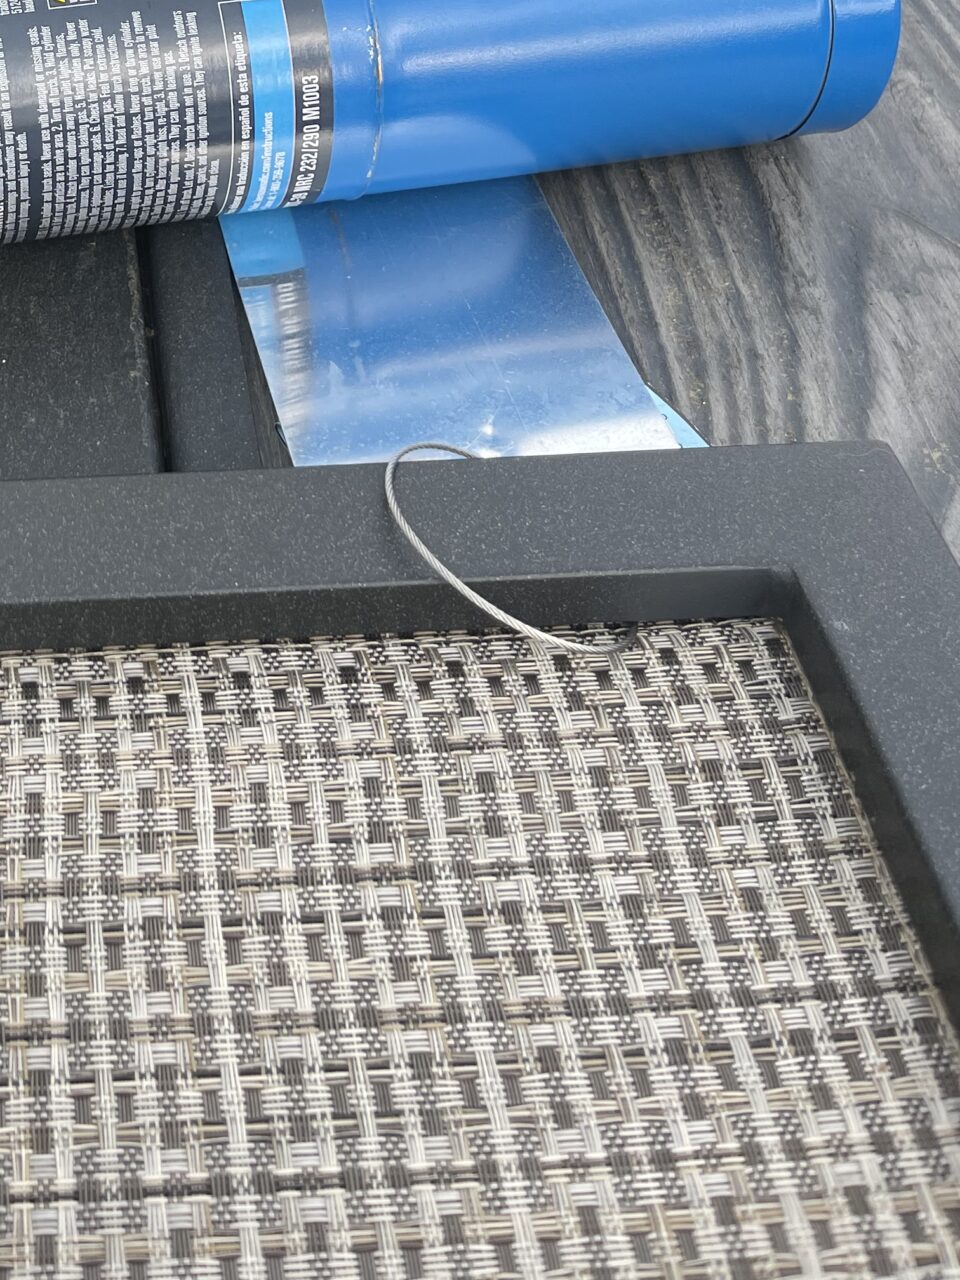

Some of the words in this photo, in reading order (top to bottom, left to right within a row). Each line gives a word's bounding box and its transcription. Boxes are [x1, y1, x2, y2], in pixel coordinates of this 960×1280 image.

[66, 22, 78, 40] Never
[78, 19, 90, 38] water
[131, 11, 144, 34] remove
[145, 24, 160, 40] pilot
[172, 11, 186, 38] outdoors
[186, 12, 198, 36] leaking
[40, 26, 54, 51] cylinder
[90, 27, 104, 42] cold.
[81, 38, 93, 58] soapy
[95, 44, 108, 70] extreme
[137, 44, 148, 58] area
[150, 42, 161, 56] near
[232, 32, 248, 70] etiqueta:
[30, 46, 43, 72] missing
[42, 52, 56, 68] Hold
[124, 50, 137, 68] throw
[152, 58, 162, 70] use
[110, 76, 122, 93] torch
[128, 78, 140, 92] drop
[236, 74, 248, 92] esta
[0, 92, 10, 100] an
[129, 94, 142, 114] Never
[238, 95, 249, 106] de
[302, 75, 320, 121] M1003
[238, 108, 252, 140] español
[241, 140, 250, 150] en
[298, 124, 320, 172] 232/290
[236, 152, 250, 186] traducción
[292, 173, 316, 192] NRC
